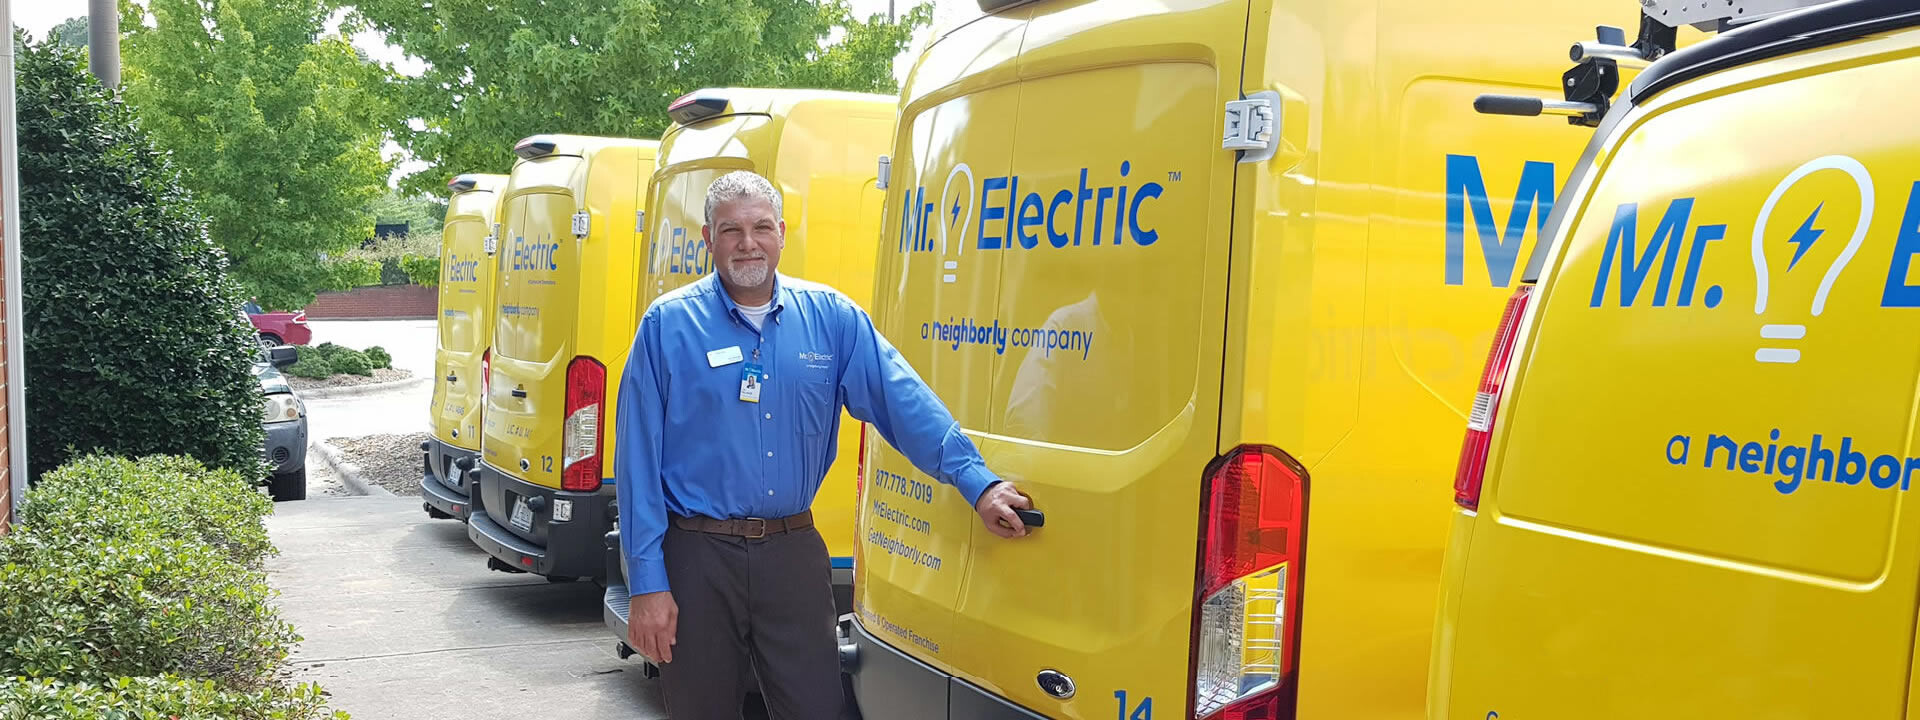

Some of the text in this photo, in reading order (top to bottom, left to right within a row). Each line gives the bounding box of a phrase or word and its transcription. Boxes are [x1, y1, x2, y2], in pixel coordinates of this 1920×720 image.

[898, 186, 934, 253] Mr.
[976, 160, 1164, 250] Electric
[450, 252, 479, 282] Electric
[513, 232, 559, 271] Electric
[1589, 197, 1728, 309] Mr.
[920, 316, 1094, 361] a neighborly company
[541, 455, 554, 473] 12
[1665, 434, 1691, 466] a
[875, 468, 933, 505] 877.778.7019
[872, 499, 931, 536] MrElectric.com
[867, 527, 942, 572] GetNeighborly.com
[881, 616, 908, 639] Operated
[908, 629, 940, 654] Franchise
